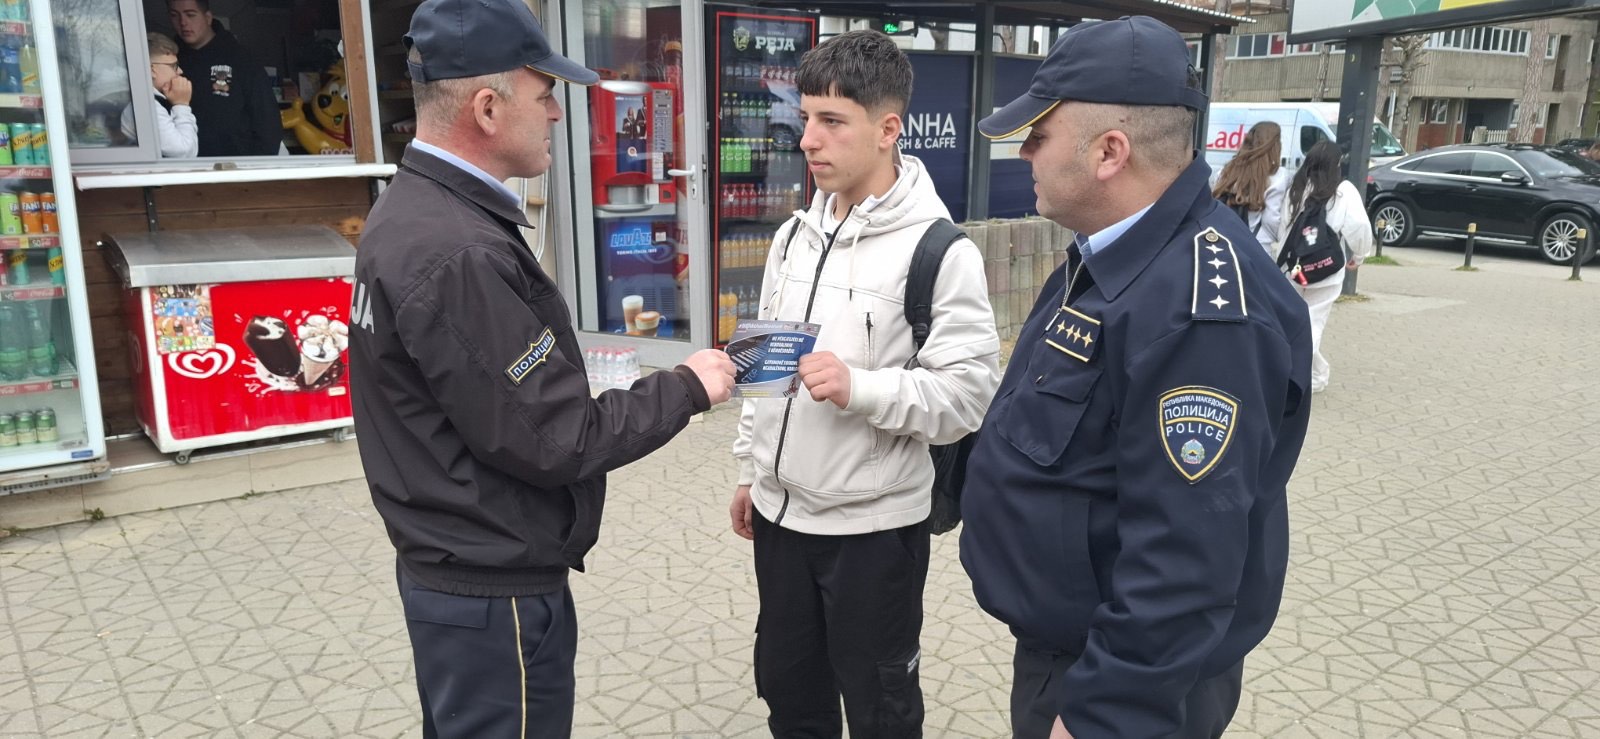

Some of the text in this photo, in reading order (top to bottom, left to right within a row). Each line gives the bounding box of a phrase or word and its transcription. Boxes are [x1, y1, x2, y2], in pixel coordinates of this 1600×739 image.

[755, 36, 796, 51] PEJA
[914, 138, 922, 149] &
[924, 137, 957, 149] CAFFE
[1206, 123, 1249, 149] ad
[610, 228, 652, 247] LAVAZ
[351, 282, 375, 335] JA
[513, 335, 553, 377] ПОЛИЦИЈА
[1162, 395, 1233, 414] РЕПУБЛИКА МАКЕДОНИЈА
[1164, 405, 1229, 426] ПОЛИЦИЈА
[1166, 422, 1226, 442] POLICE
